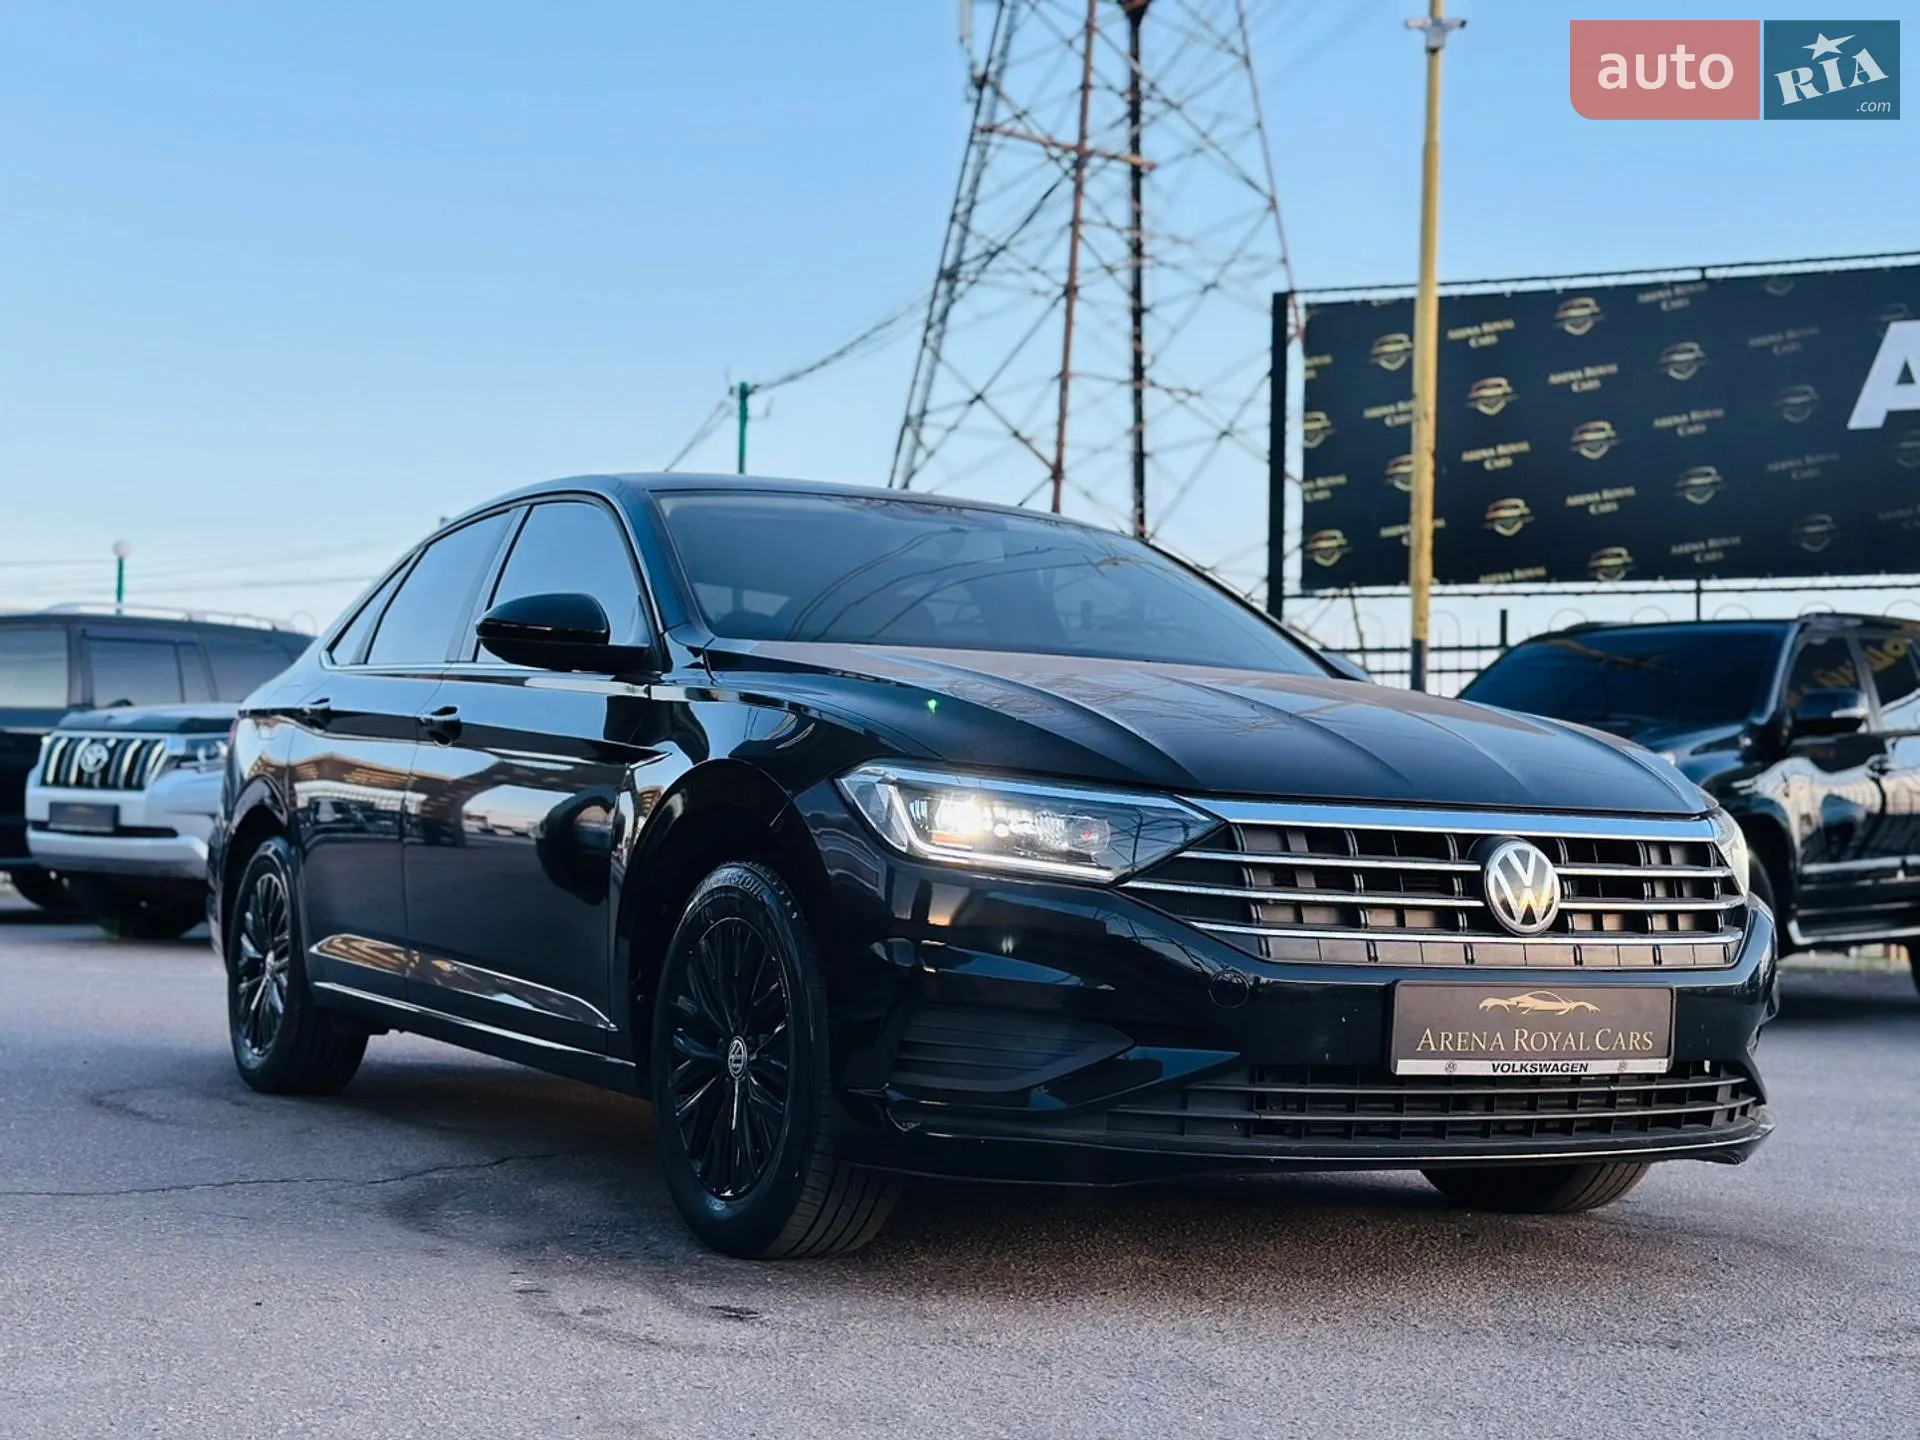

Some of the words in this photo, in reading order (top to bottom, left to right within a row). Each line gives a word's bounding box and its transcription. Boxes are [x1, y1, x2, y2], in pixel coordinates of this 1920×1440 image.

[1416, 1027, 1505, 1051] ARENA
[1514, 1028, 1590, 1051] ROYAL
[1595, 1027, 1654, 1051] CARS
[1491, 1062, 1589, 1073] VOLKSWAGEN
